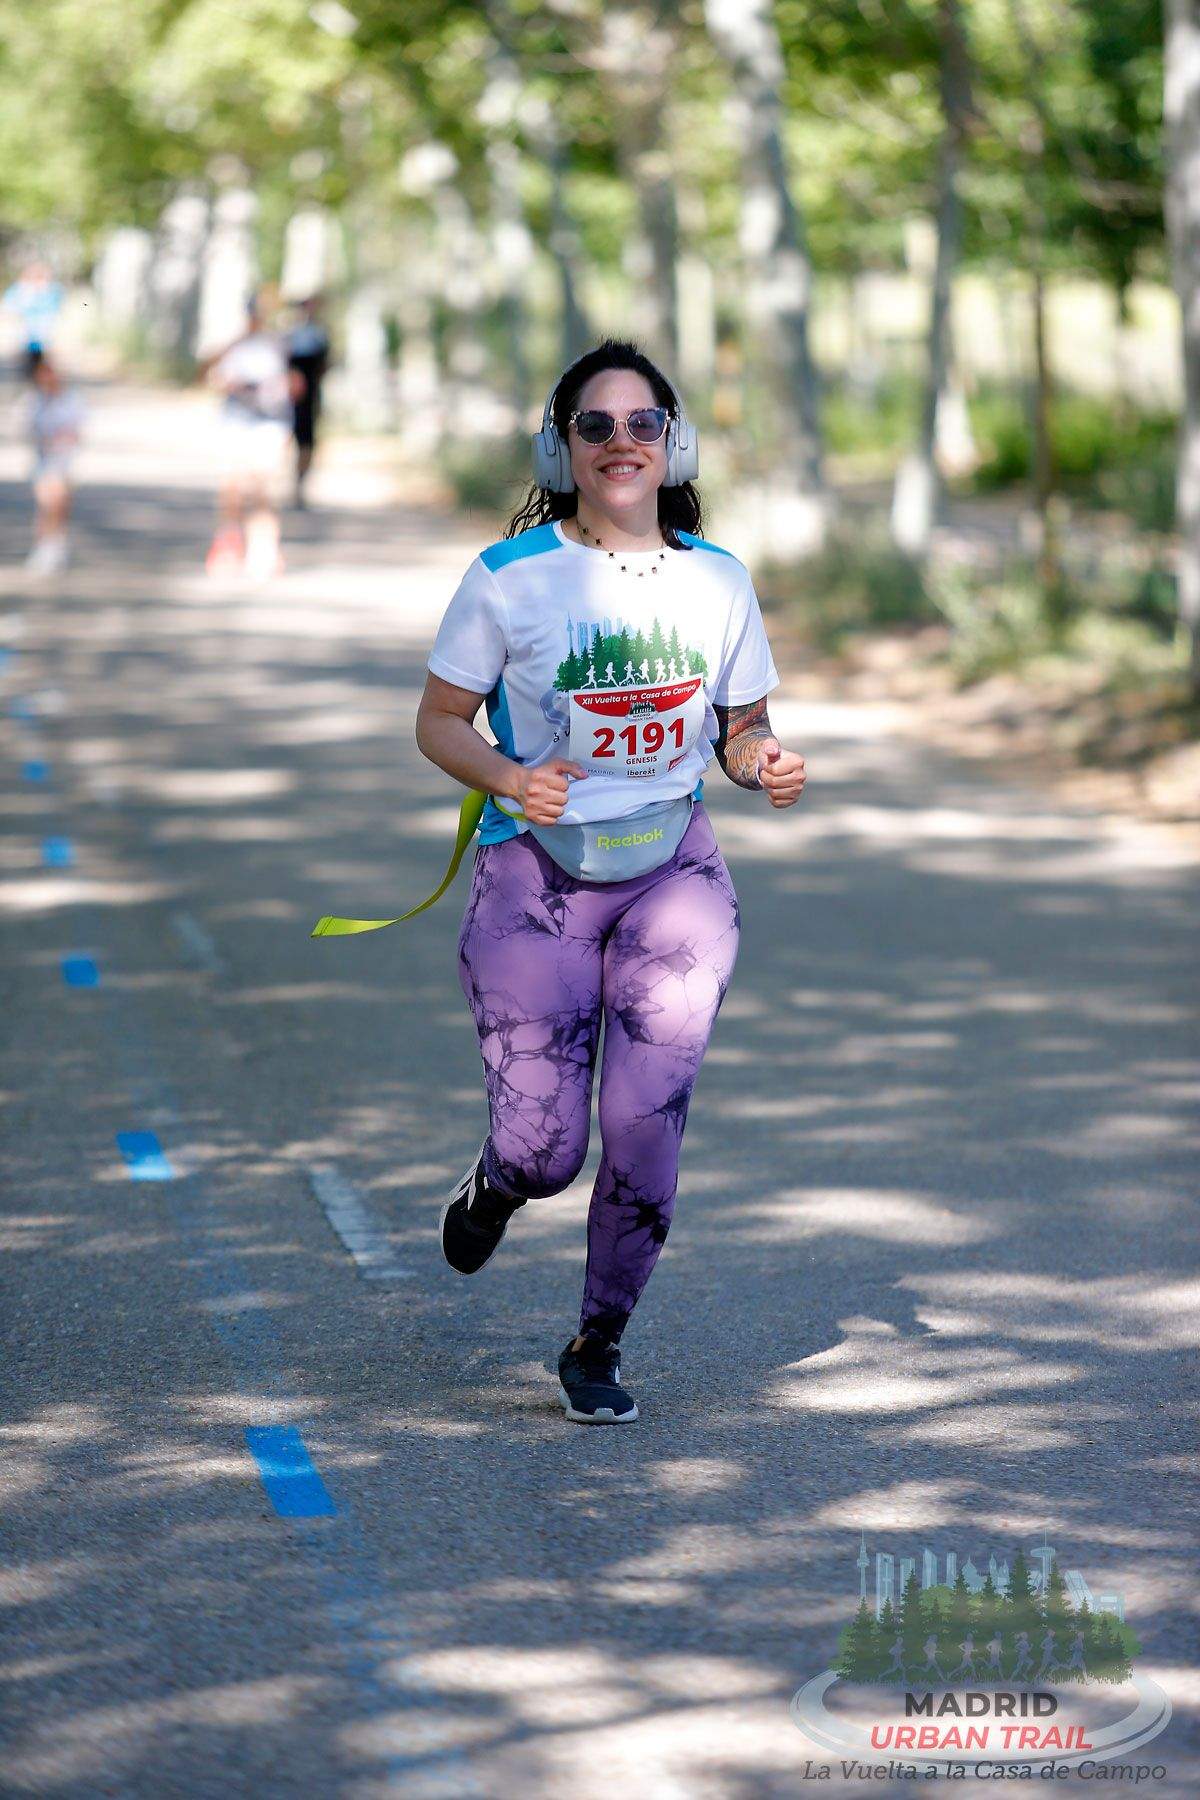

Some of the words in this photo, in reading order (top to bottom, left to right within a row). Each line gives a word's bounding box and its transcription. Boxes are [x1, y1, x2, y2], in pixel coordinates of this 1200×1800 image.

[595, 696, 621, 704] Vuelta
[640, 691, 660, 700] Casa
[661, 689, 671, 697] de
[672, 684, 696, 695] Campo
[592, 718, 684, 758] 2191
[626, 755, 658, 765] GENESIS
[597, 828, 663, 850] Reebok
